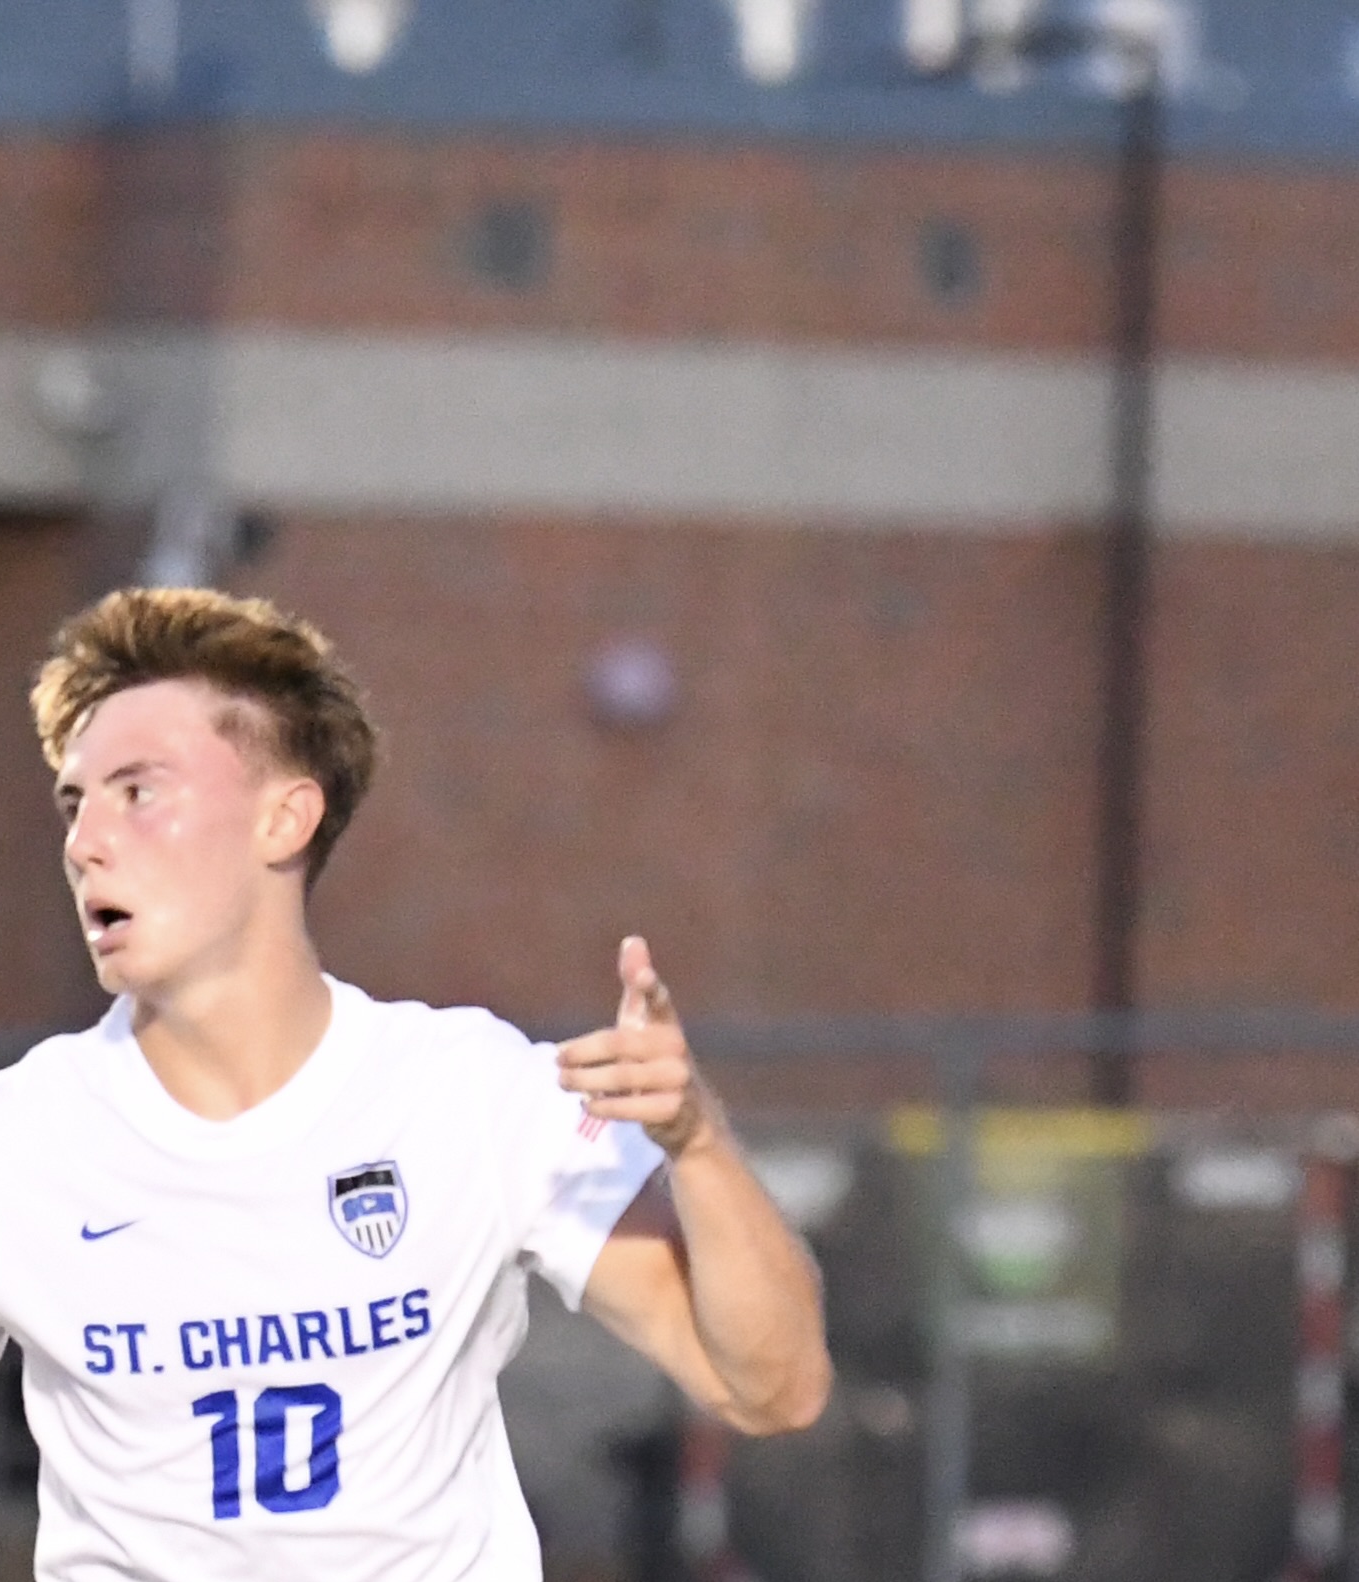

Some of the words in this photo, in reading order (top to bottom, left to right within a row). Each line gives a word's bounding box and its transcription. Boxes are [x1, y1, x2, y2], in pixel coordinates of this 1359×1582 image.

[83, 1323, 165, 1375] ST.
[179, 1288, 432, 1371] CHARLES
[191, 1383, 342, 1519] 10
